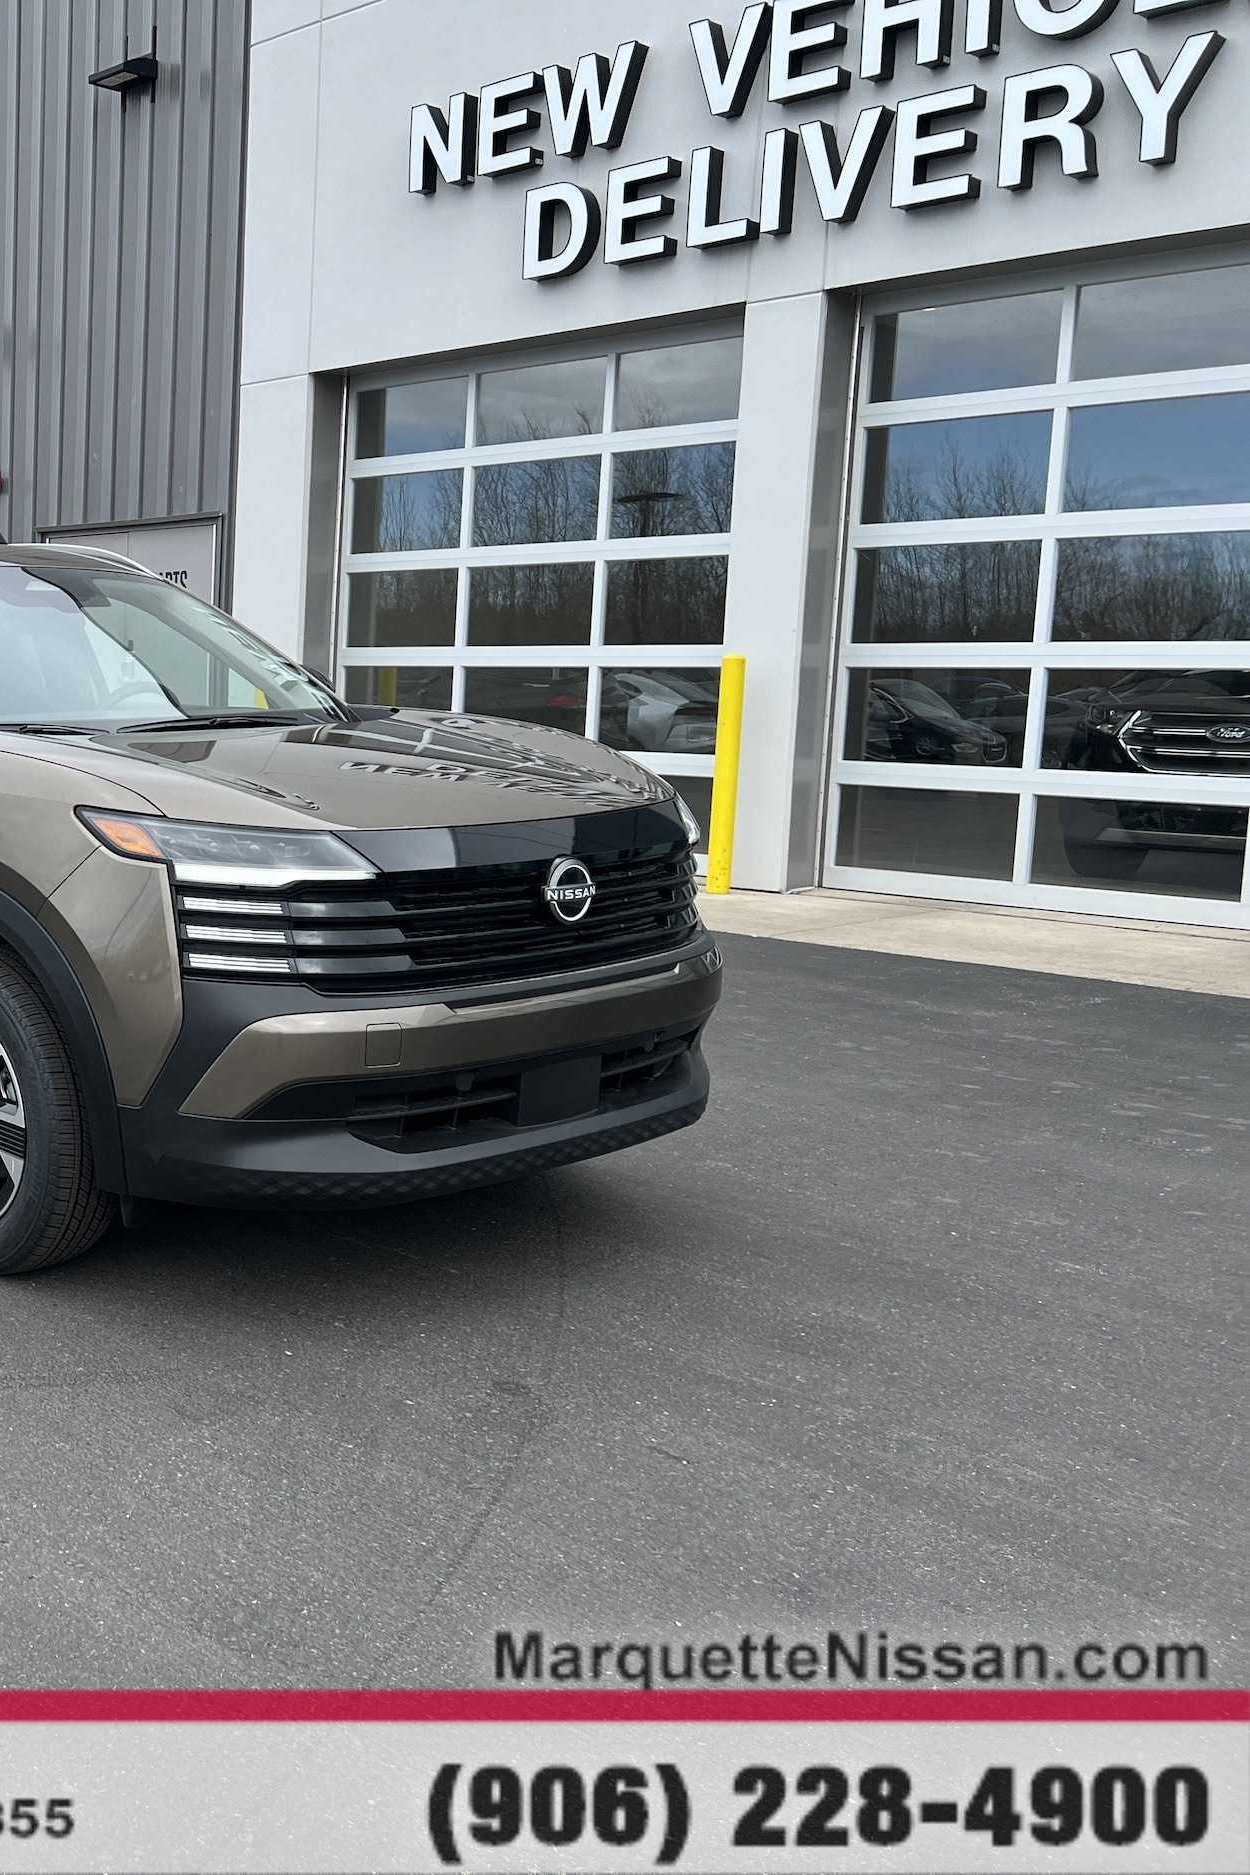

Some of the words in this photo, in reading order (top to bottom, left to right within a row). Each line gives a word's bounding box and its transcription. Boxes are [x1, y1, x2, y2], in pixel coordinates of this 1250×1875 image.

[409, 40, 648, 195] NEW
[522, 30, 1227, 281] DELIVERY
[1216, 727, 1246, 739] Ford
[546, 885, 596, 900] NISSAN
